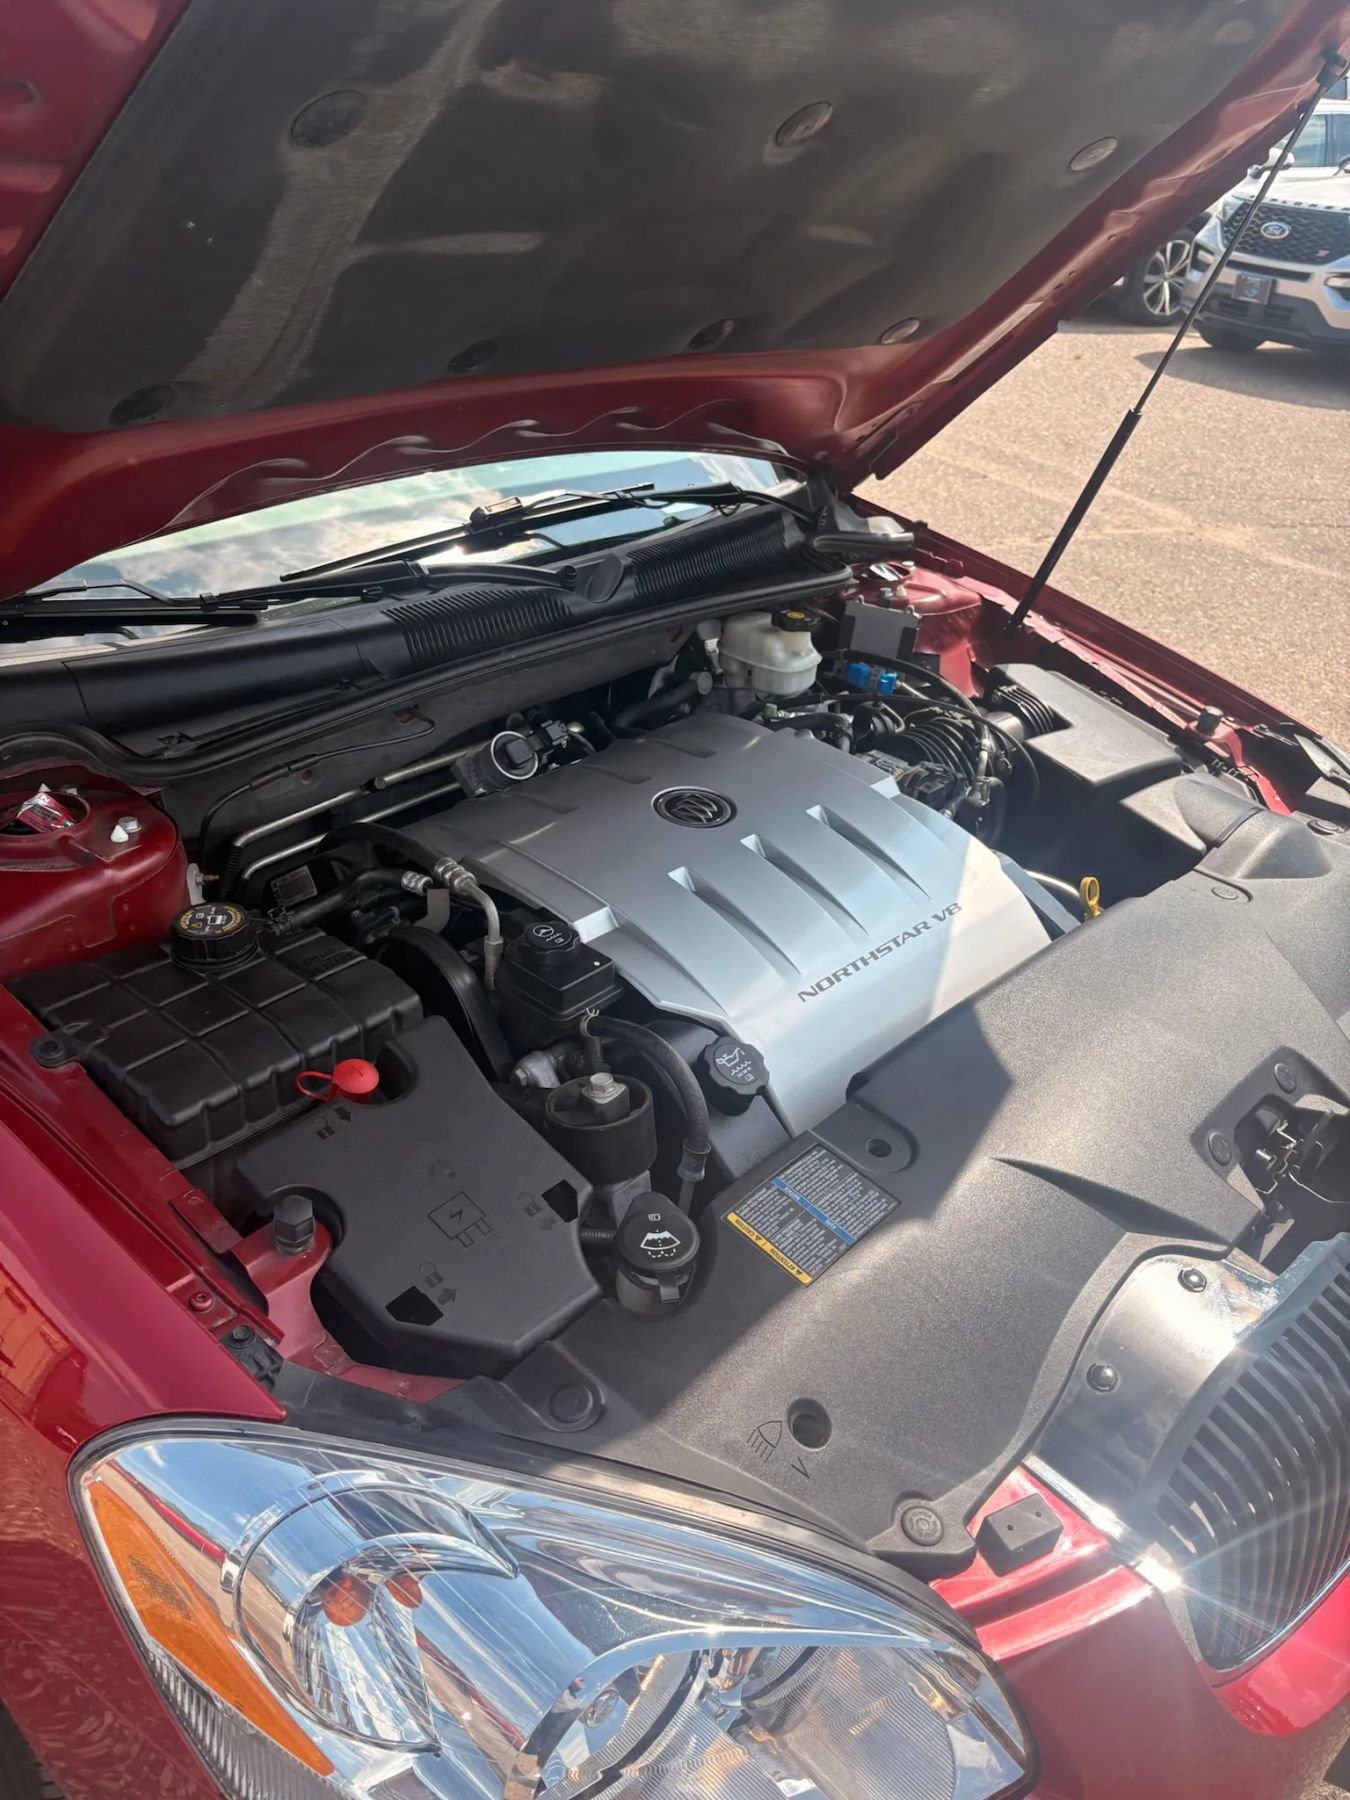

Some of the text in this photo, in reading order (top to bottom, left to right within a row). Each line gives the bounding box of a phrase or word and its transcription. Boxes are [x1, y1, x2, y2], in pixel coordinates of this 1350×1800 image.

[797, 902, 963, 1002] NORTHSTAR V8
[734, 1218, 756, 1237] CAUTION
[769, 1248, 796, 1271] ATTENTION
